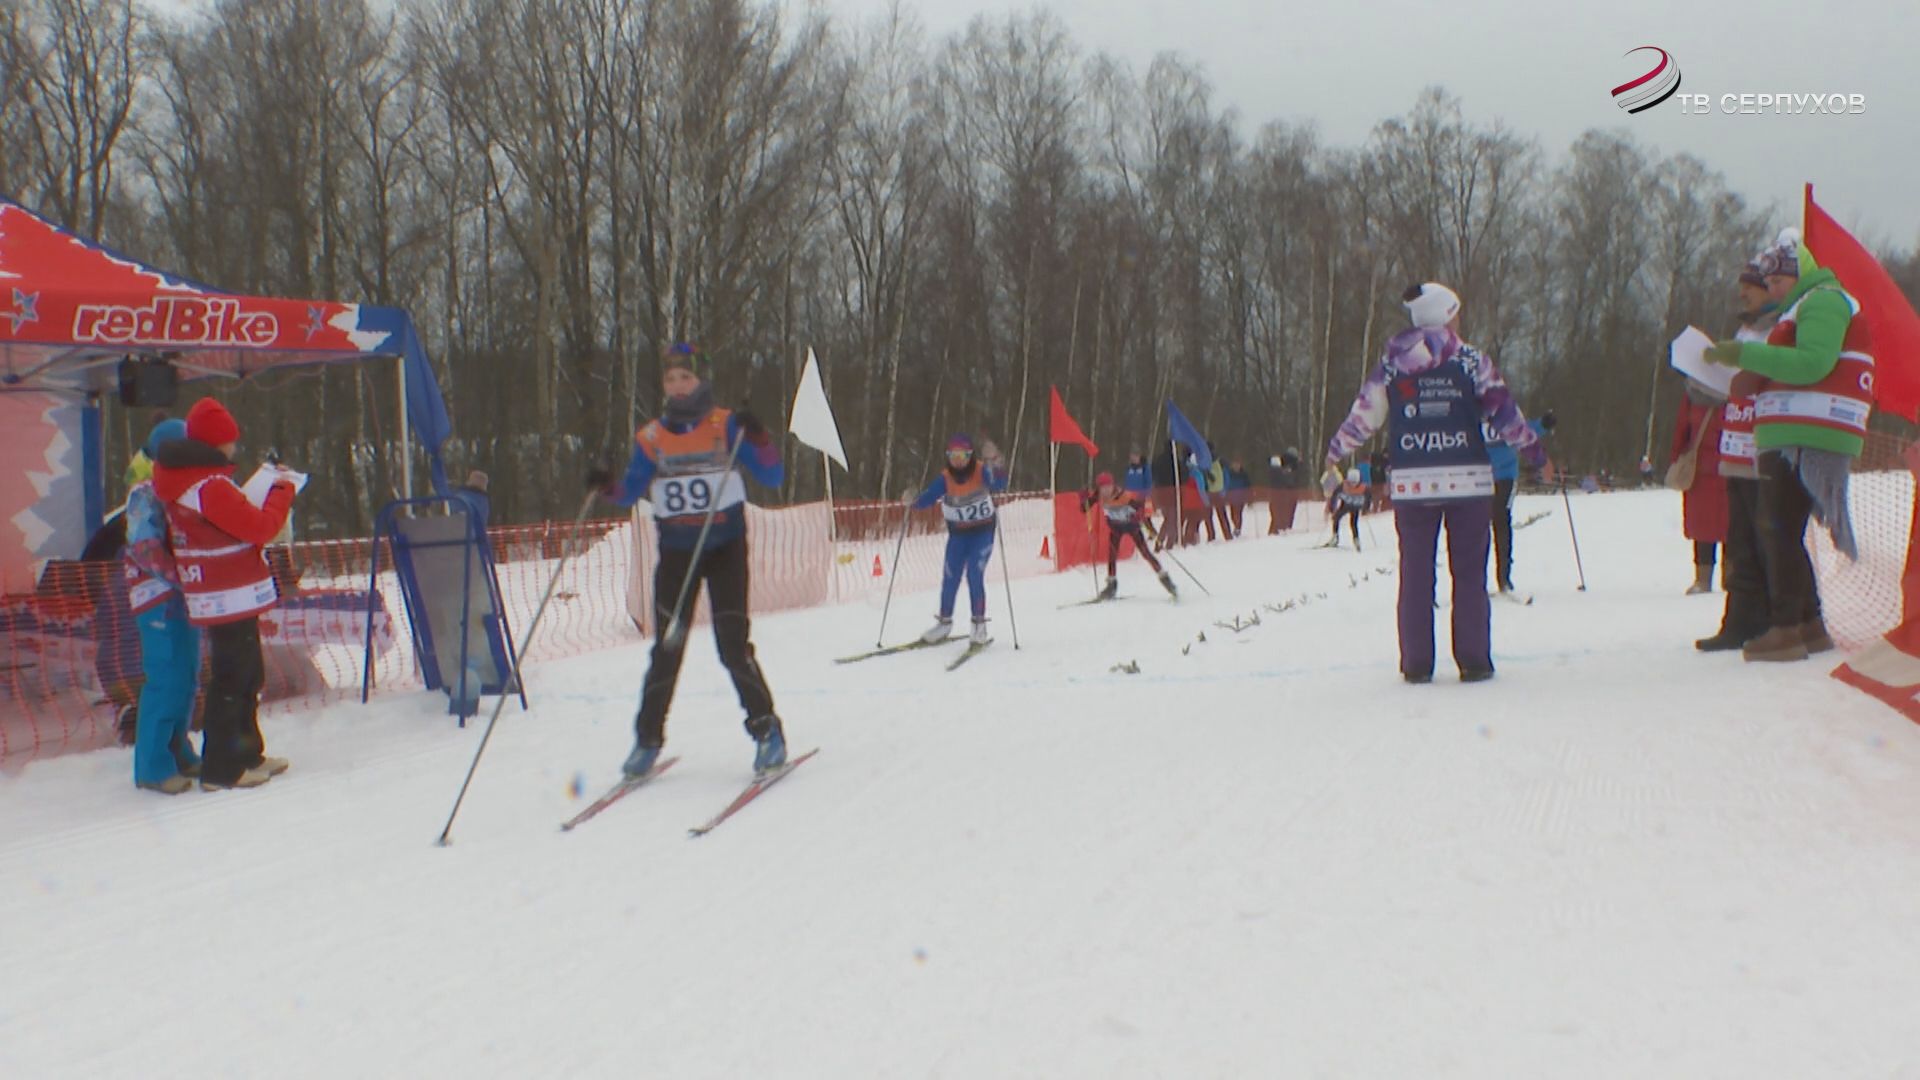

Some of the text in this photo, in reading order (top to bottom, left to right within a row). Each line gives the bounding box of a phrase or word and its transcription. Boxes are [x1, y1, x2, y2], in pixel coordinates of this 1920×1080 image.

[73, 296, 278, 347] redBike
[1400, 431, 1468, 452] СУДЬЯ
[664, 478, 711, 513] 89
[956, 500, 992, 521] 126
